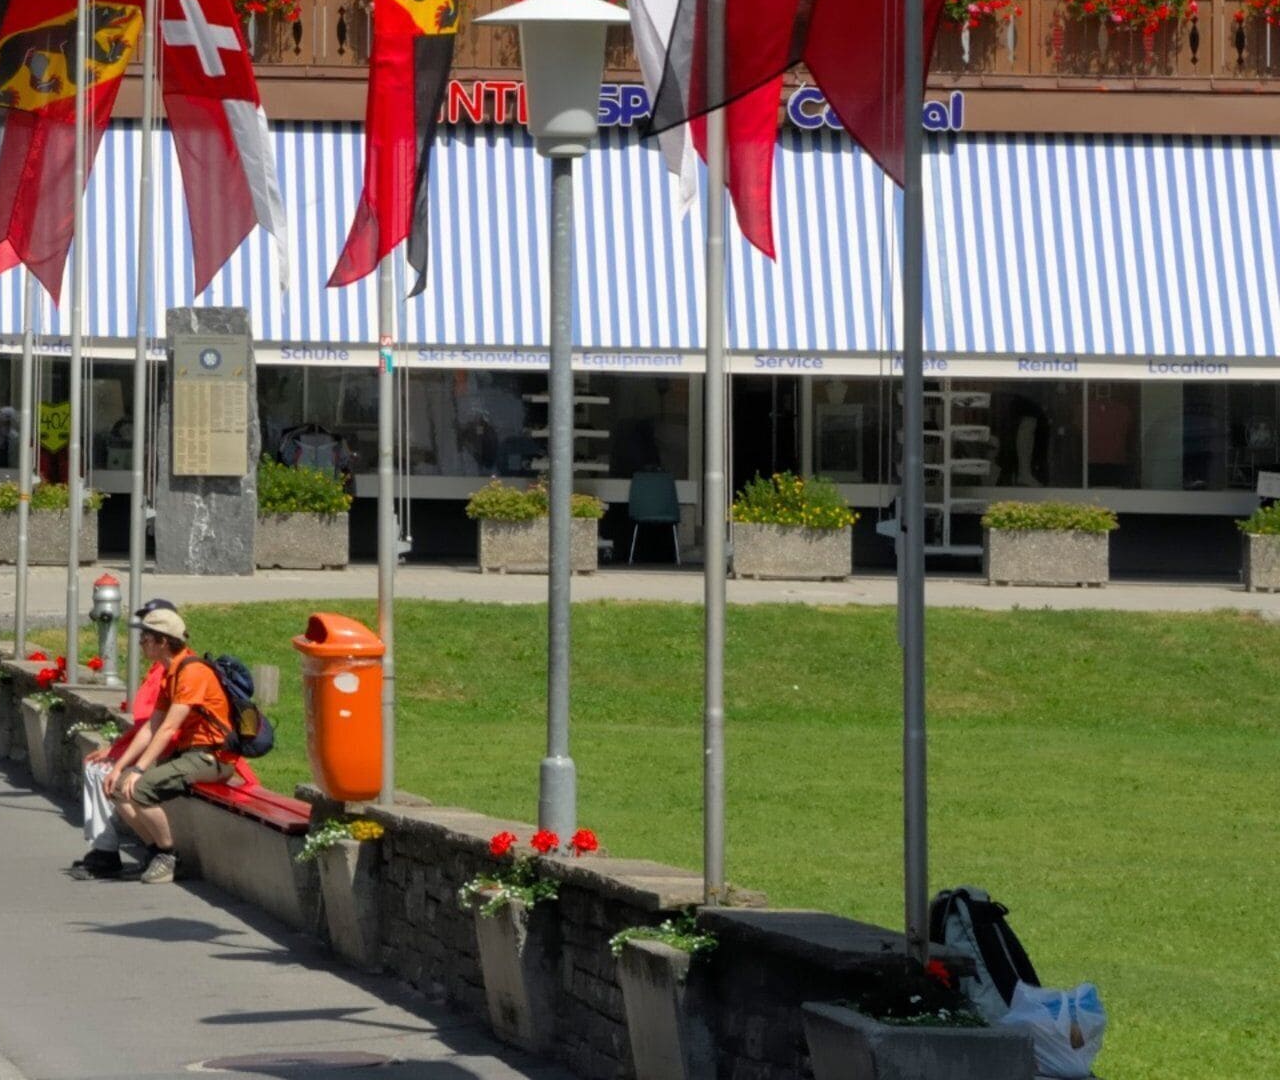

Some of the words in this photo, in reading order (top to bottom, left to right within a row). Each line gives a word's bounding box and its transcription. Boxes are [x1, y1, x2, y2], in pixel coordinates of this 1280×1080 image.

[280, 346, 349, 361] Schuhe
[754, 354, 823, 369] Service
[1018, 356, 1078, 373] Rental
[1148, 358, 1229, 374] Location
